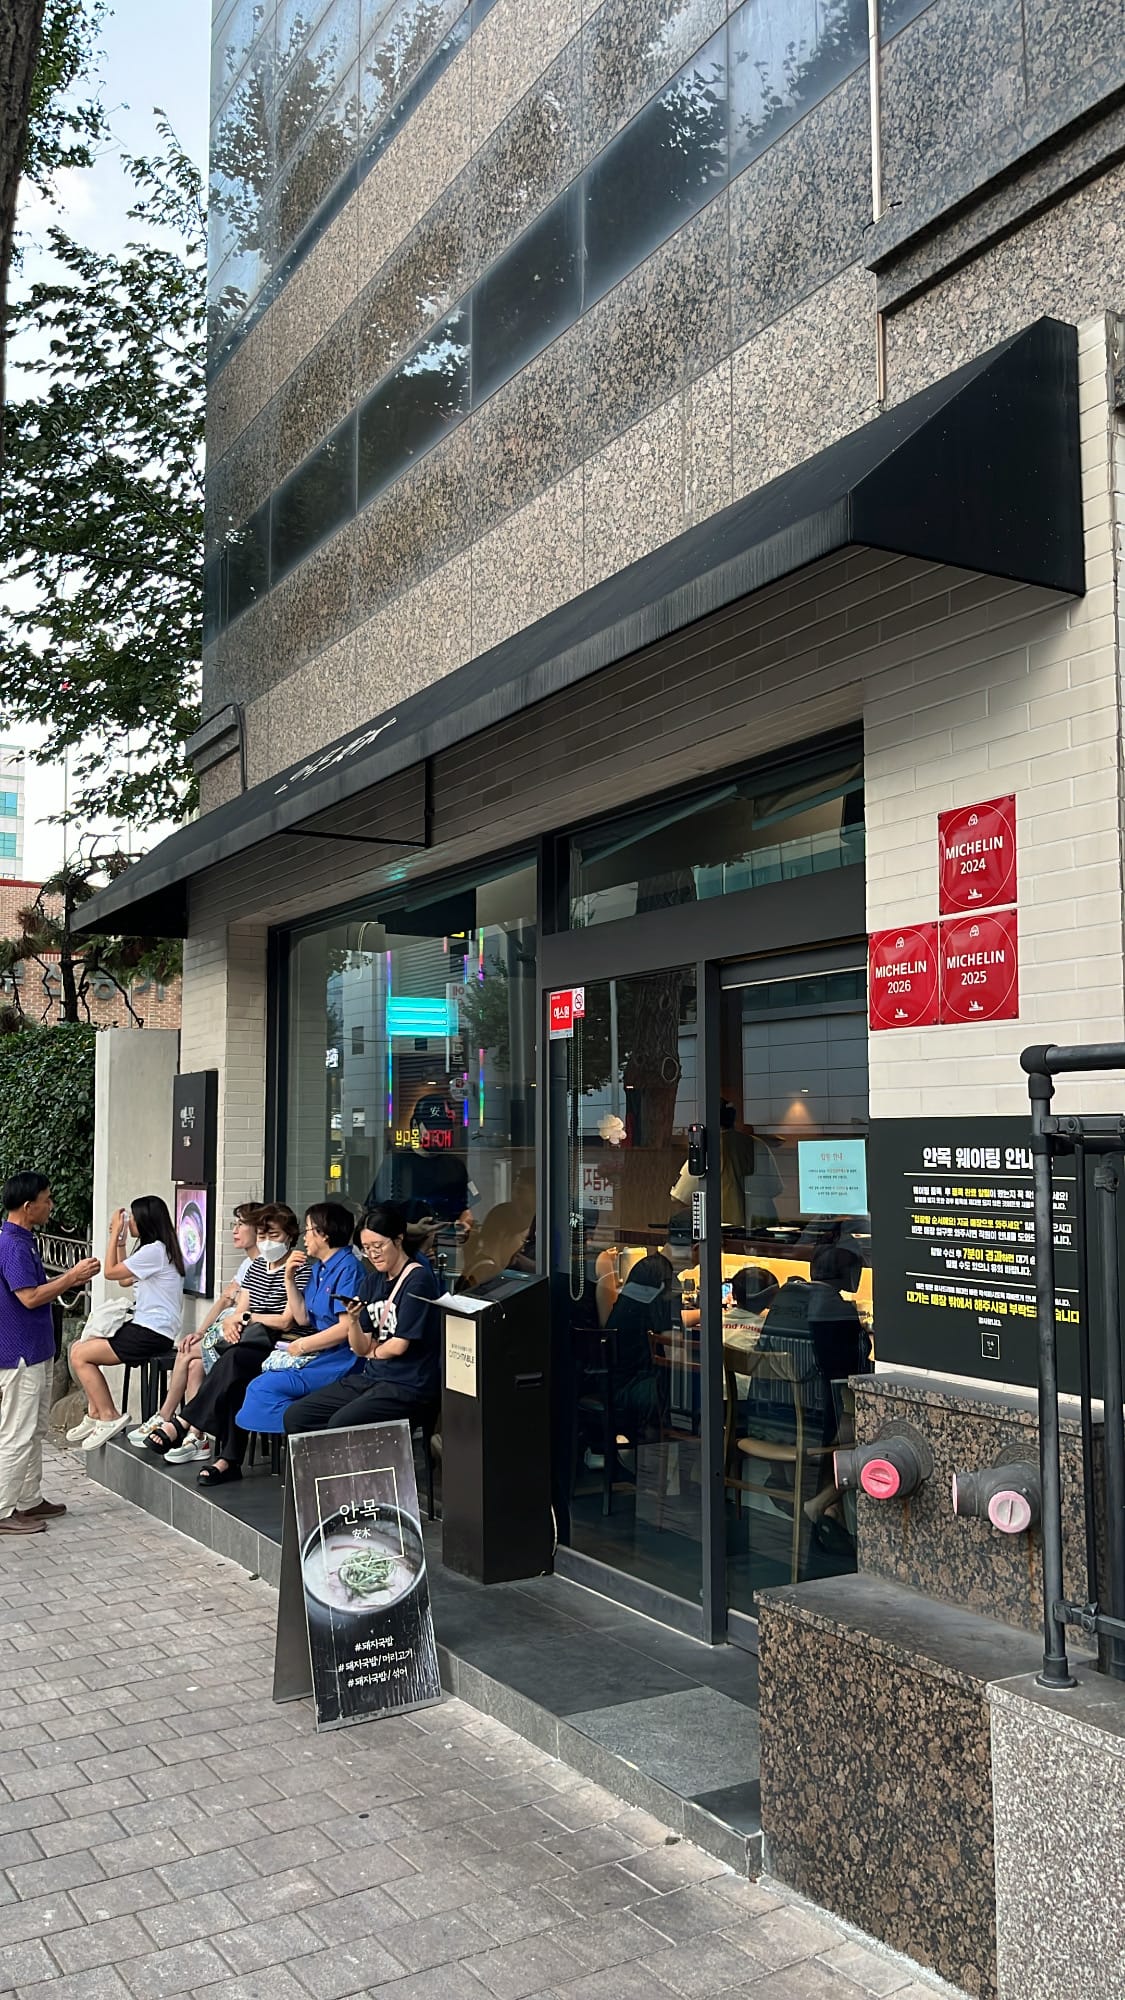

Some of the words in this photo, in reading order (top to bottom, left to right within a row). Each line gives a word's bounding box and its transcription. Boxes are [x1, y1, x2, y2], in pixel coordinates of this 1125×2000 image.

[945, 835, 1004, 860] MICHELIN
[960, 858, 986, 875] 2024
[946, 949, 1005, 970] MICHELIN
[875, 960, 927, 979] MICHELIN
[961, 970, 987, 986] 2025
[887, 980, 912, 994] 2026
[553, 1005, 570, 1019] 에스원
[922, 1147, 952, 1169] 안목
[955, 1147, 1001, 1170] 웨이팅
[962, 1247, 984, 1261] 7분이
[985, 1249, 1015, 1264] 경과하면
[1015, 1255, 1029, 1265] 대기
[906, 1290, 930, 1305] 대기는
[930, 1293, 947, 1307] 매장
[948, 1295, 973, 1311] 밖에서
[974, 1298, 1008, 1316] 해주시길
[339, 1498, 380, 1525] 안목
